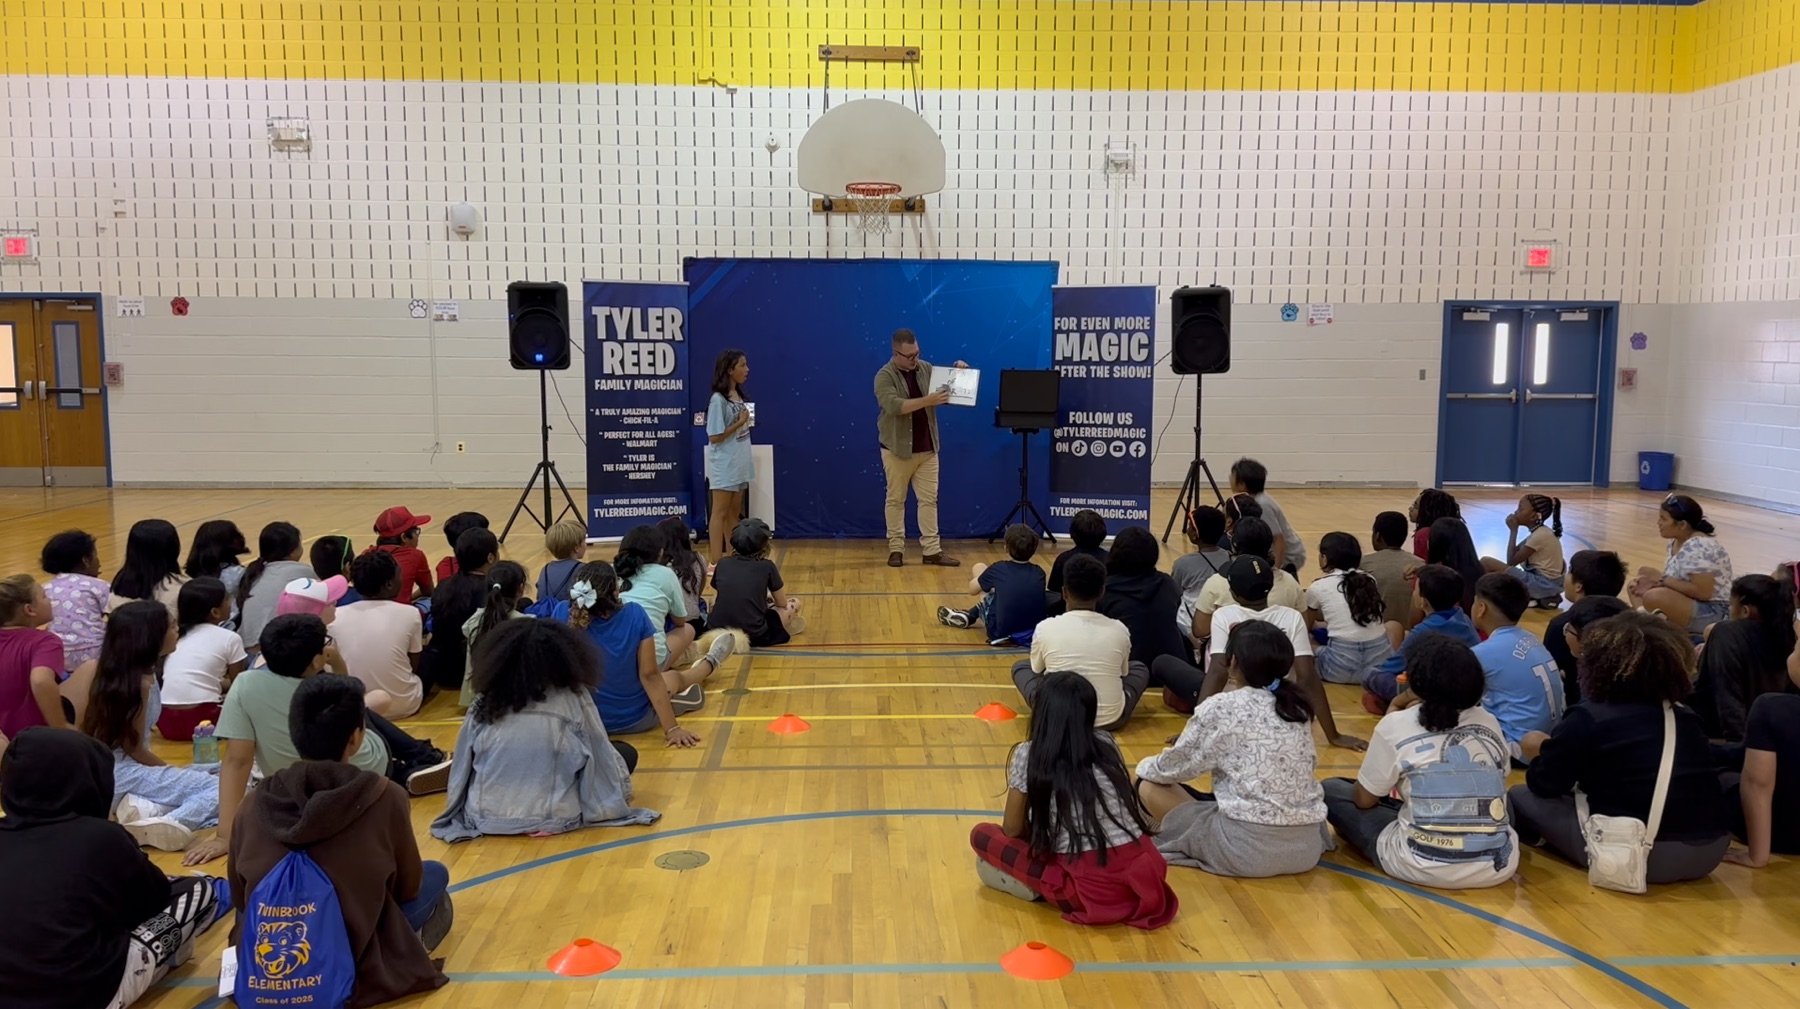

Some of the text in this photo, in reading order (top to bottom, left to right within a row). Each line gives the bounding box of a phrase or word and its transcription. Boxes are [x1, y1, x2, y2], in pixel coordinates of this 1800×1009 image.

[591, 306, 684, 341] TYLER
[1054, 316, 1150, 330] FOR EVEN MORE
[1055, 332, 1149, 362] MAGIC
[602, 341, 675, 376] REED
[1090, 366, 1109, 378] THE
[1113, 365, 1152, 378] SHOW!
[594, 379, 683, 390] FAMILY MAGICIAN
[601, 408, 620, 416] TRULY
[1069, 411, 1133, 425] FOLLOW US
[604, 431, 630, 439] PERFECT
[657, 430, 675, 438] AGES!
[1053, 427, 1147, 439] @TYLERREEDMAGIC
[626, 440, 658, 448] WALMART
[1055, 442, 1069, 453] ON
[628, 454, 647, 462] TYLER
[615, 463, 639, 471] FAMILY
[629, 472, 656, 480] HERSHEY
[1122, 499, 1138, 507] VISIT:
[594, 505, 687, 518] TYLERREEDMAGIC.COM
[1049, 506, 1148, 520] TYLERMAGIC.COM
[1414, 832, 1454, 846] GOLF 1976
[248, 974, 322, 991] ELEMENTARY
[255, 995, 314, 1005] Class of 2025
